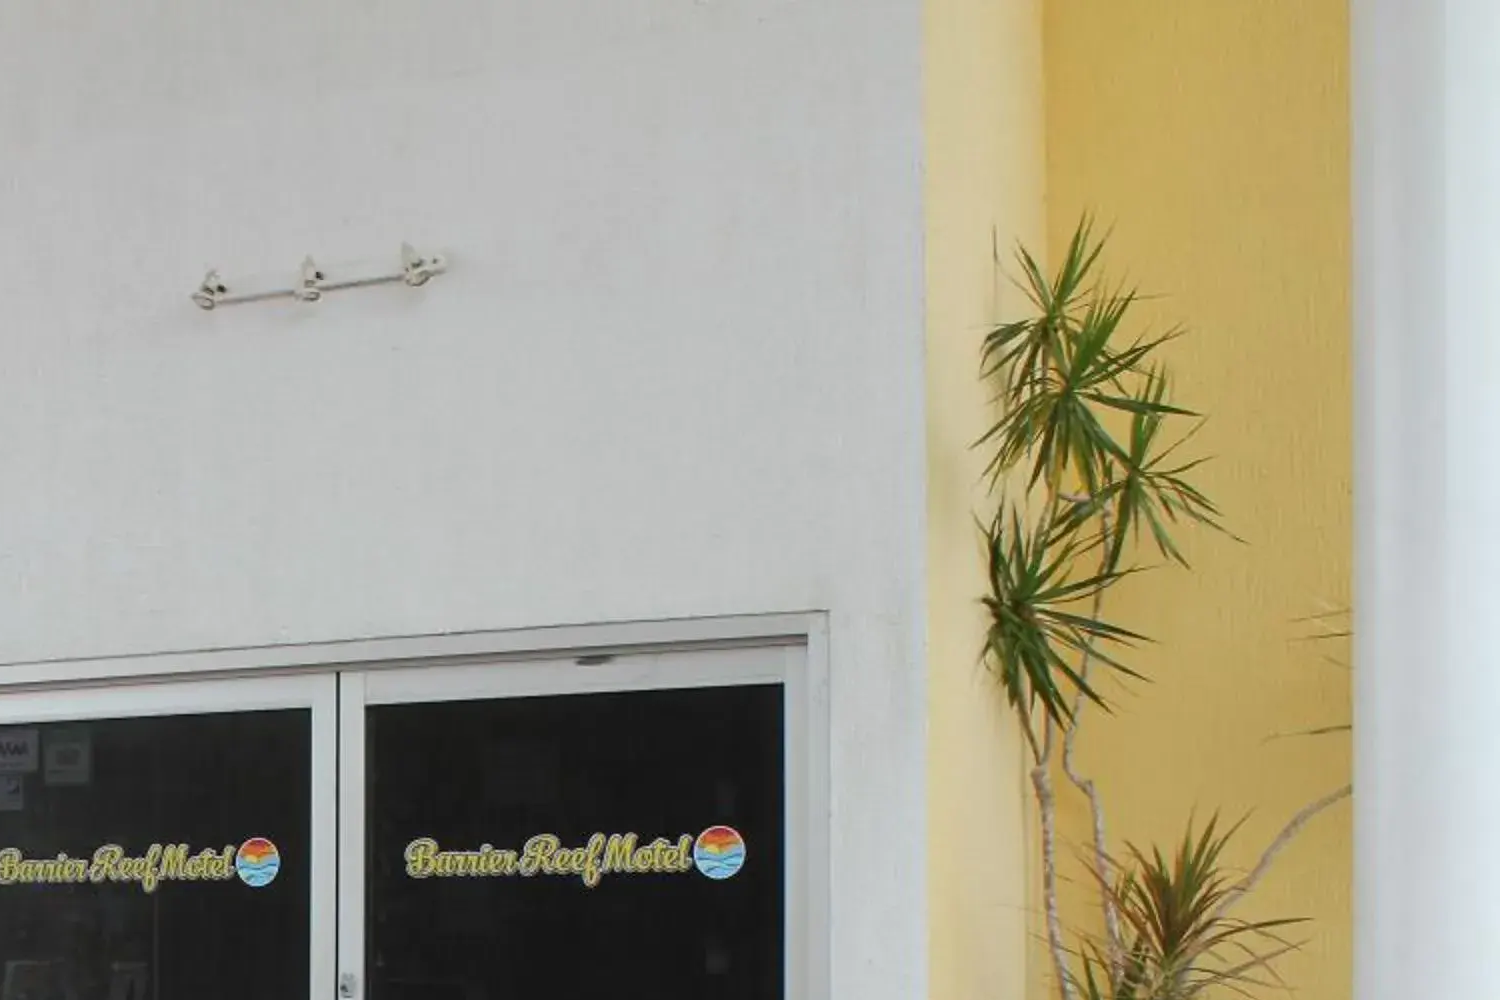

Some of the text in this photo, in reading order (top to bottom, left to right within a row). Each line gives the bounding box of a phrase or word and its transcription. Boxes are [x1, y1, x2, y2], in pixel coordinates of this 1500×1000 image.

[88, 843, 161, 893] Reef
[156, 843, 236, 882] Motel
[404, 832, 693, 888] Barrier Reef Motel
